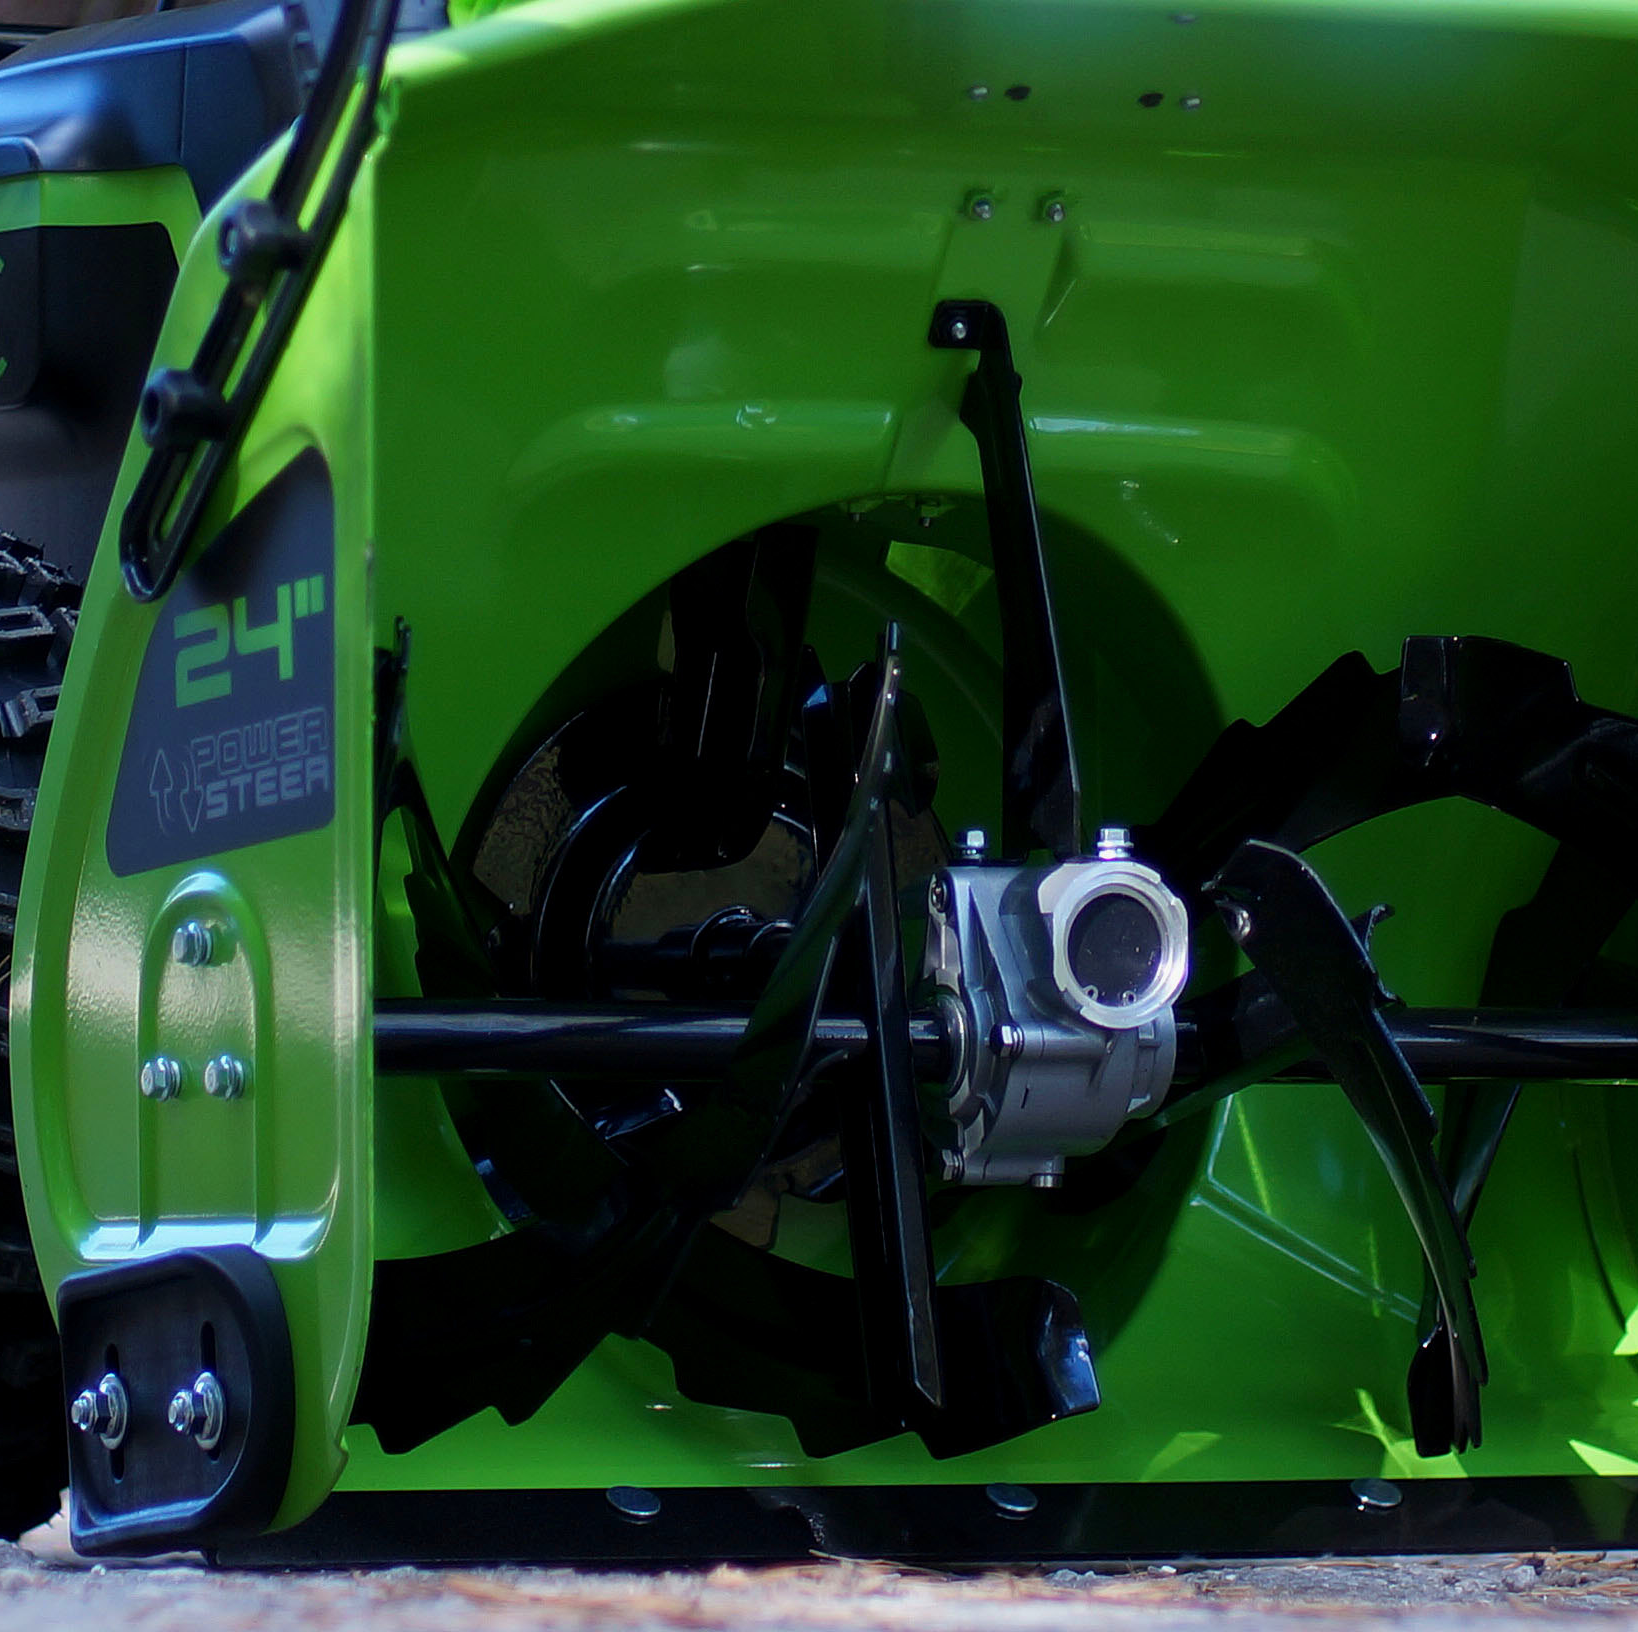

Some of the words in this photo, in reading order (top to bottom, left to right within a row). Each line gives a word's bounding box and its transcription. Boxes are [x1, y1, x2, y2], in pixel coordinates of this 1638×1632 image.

[173, 574, 325, 708] 24"
[190, 705, 328, 776] POWER
[205, 756, 329, 820] STEER
